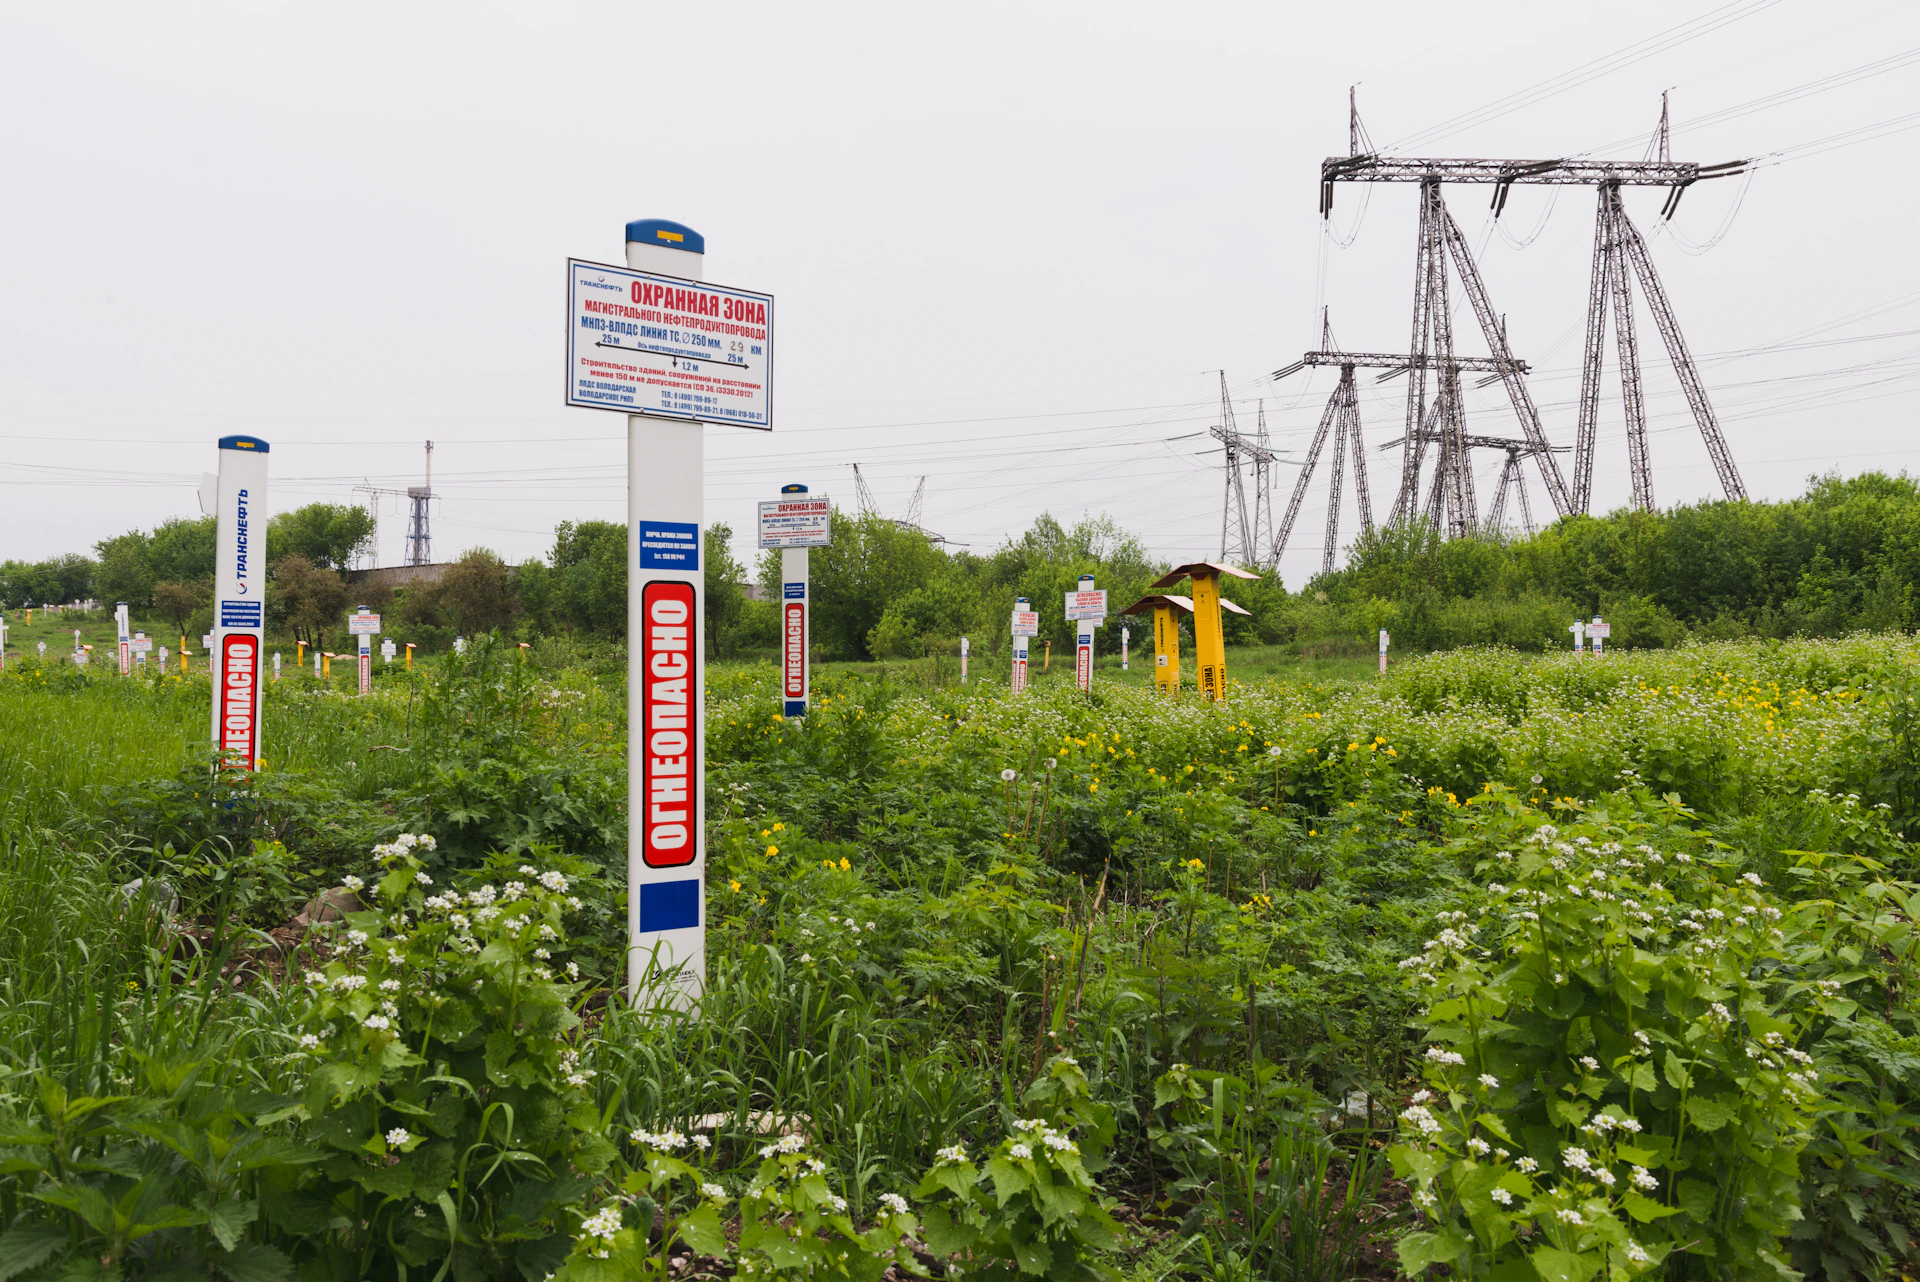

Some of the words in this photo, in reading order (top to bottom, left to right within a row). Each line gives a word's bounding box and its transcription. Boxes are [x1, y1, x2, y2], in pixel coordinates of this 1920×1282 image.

[580, 280, 622, 292] ТРАНСНЕФТЬ
[631, 280, 719, 318] ОХРАННАЯ
[724, 297, 766, 326] ЗОНА
[585, 300, 662, 323] МАГИСТРАЛЬНОГО
[664, 312, 766, 341] НЕФТЕПРОДУКТОПРОВОДА
[582, 316, 638, 337] МНПЗ-ВЛПДС
[640, 325, 668, 340] ЛИНИЯ
[692, 334, 706, 346] 250
[602, 334, 612, 344] 25
[730, 340, 744, 352] 29
[728, 353, 736, 362] 25
[581, 358, 637, 372] Строительство
[668, 371, 712, 382] сооружений
[722, 379, 761, 390] расстоянии
[590, 370, 613, 378] менее
[646, 378, 692, 389] допускается
[579, 390, 619, 401] ВОЛОДАРСКОЕ
[596, 382, 636, 394] ВОЛОДАРСКАЯ
[778, 503, 809, 512] ОХРАННАЯ
[811, 502, 827, 510] ЗОНА
[237, 489, 248, 580] ТРАНСНЕФТЬ
[788, 609, 802, 692] ОГНЕОПАСНО
[1204, 668, 1214, 688] ЗОНА
[651, 599, 688, 850] ОГНЕОПАСНО
